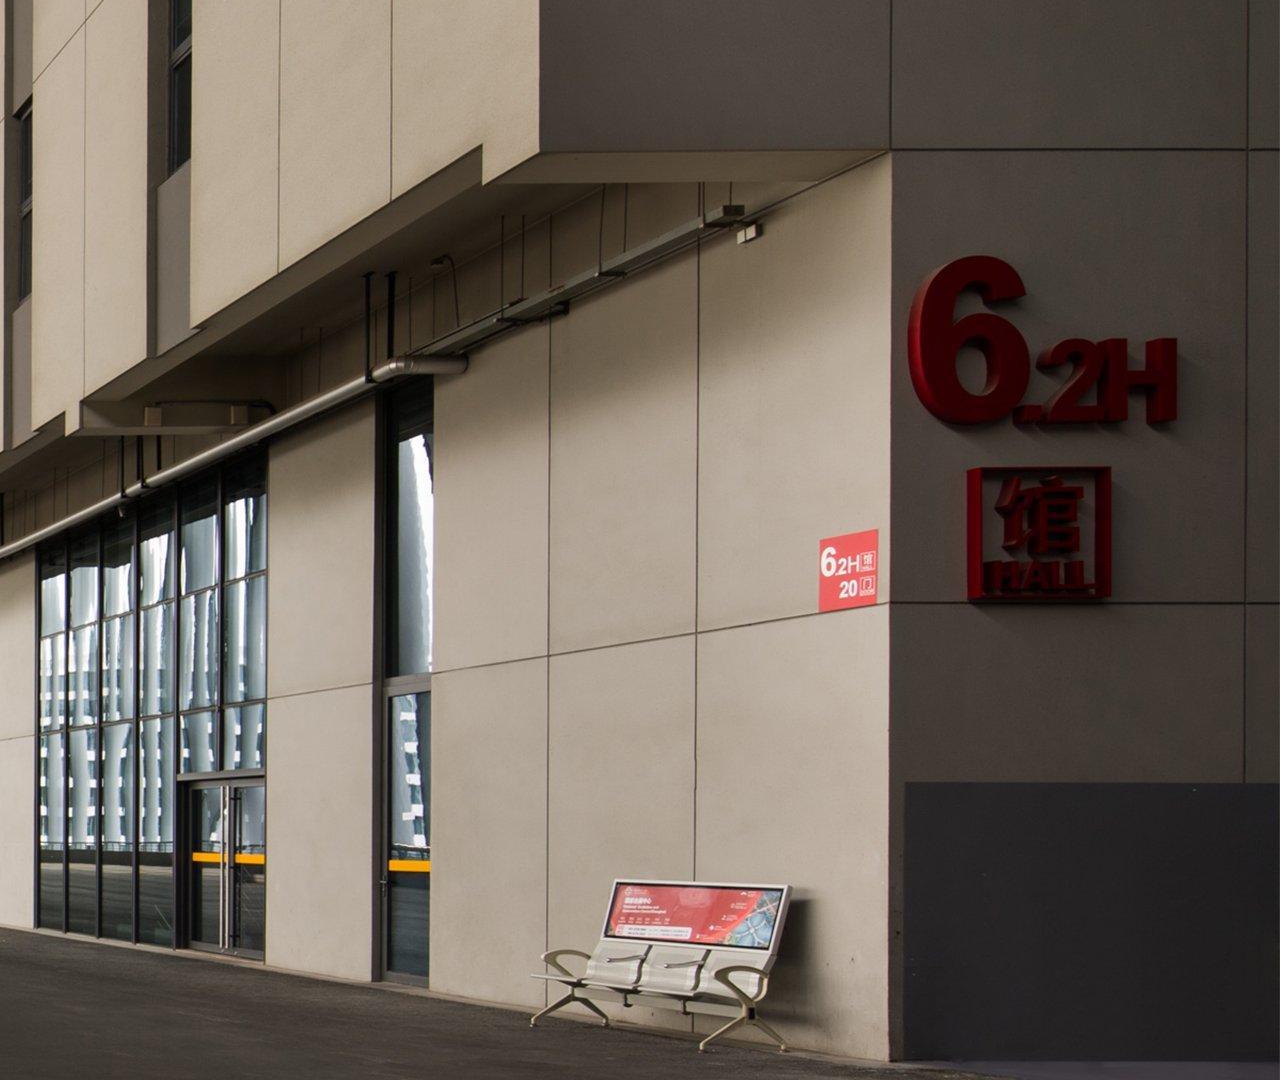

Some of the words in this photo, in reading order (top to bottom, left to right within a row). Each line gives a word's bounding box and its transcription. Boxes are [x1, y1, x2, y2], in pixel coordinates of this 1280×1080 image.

[908, 255, 1178, 426] 6.2H
[993, 475, 1085, 557] 馆
[820, 546, 860, 577] 6.2H
[981, 560, 1098, 593] HALL
[838, 579, 858, 599] 20
